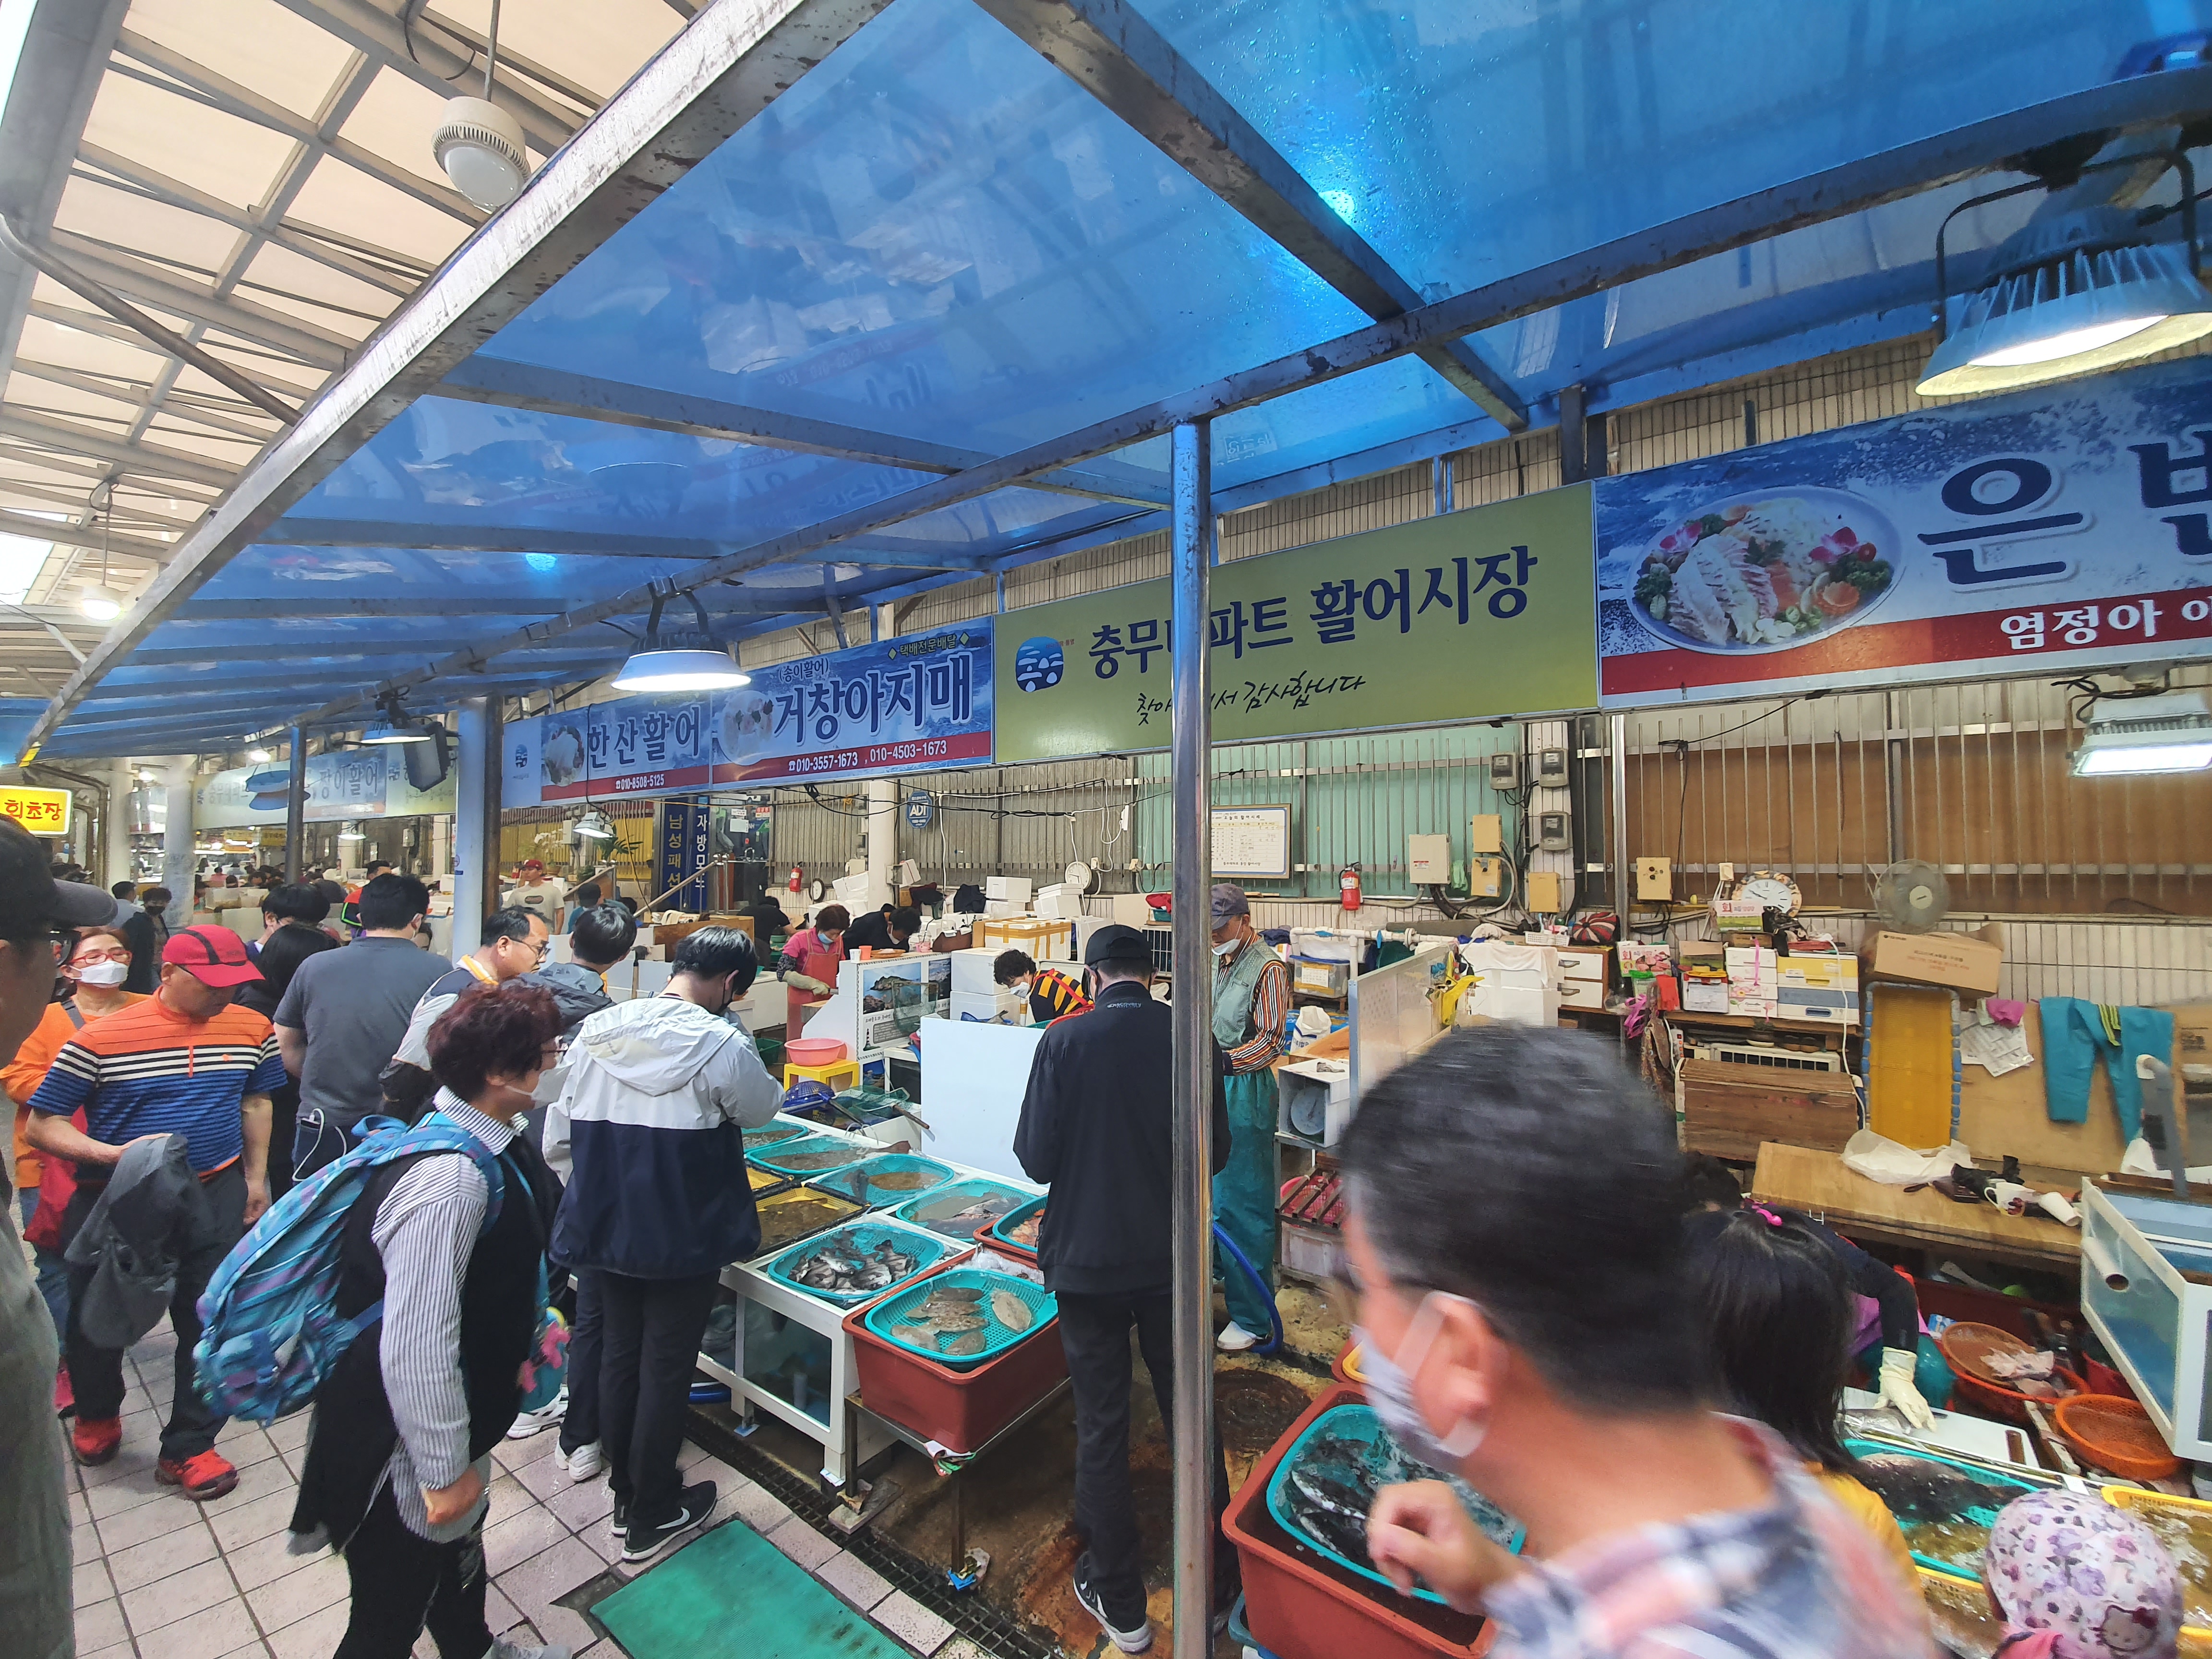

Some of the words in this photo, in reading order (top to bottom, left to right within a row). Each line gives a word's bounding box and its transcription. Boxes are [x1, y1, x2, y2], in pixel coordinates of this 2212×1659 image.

[1089, 597, 1295, 679] 충무파트
[1310, 545, 1539, 643] 활어시장
[2000, 600, 2163, 650] 염정아
[900, 634, 957, 657] 택배전문배달
[779, 657, 830, 683] (송이활어)
[774, 654, 970, 743] 거창아지매
[1137, 689, 1238, 726] 찾아서
[1244, 670, 1367, 714] 감사합니다
[589, 707, 700, 769] 한산활어
[796, 752, 858, 772] 010-3557-1673
[621, 774, 665, 790] 010-8508-5125
[4, 799, 62, 821] 회초장
[909, 802, 929, 817] ADT
[667, 814, 684, 888] 남성패션
